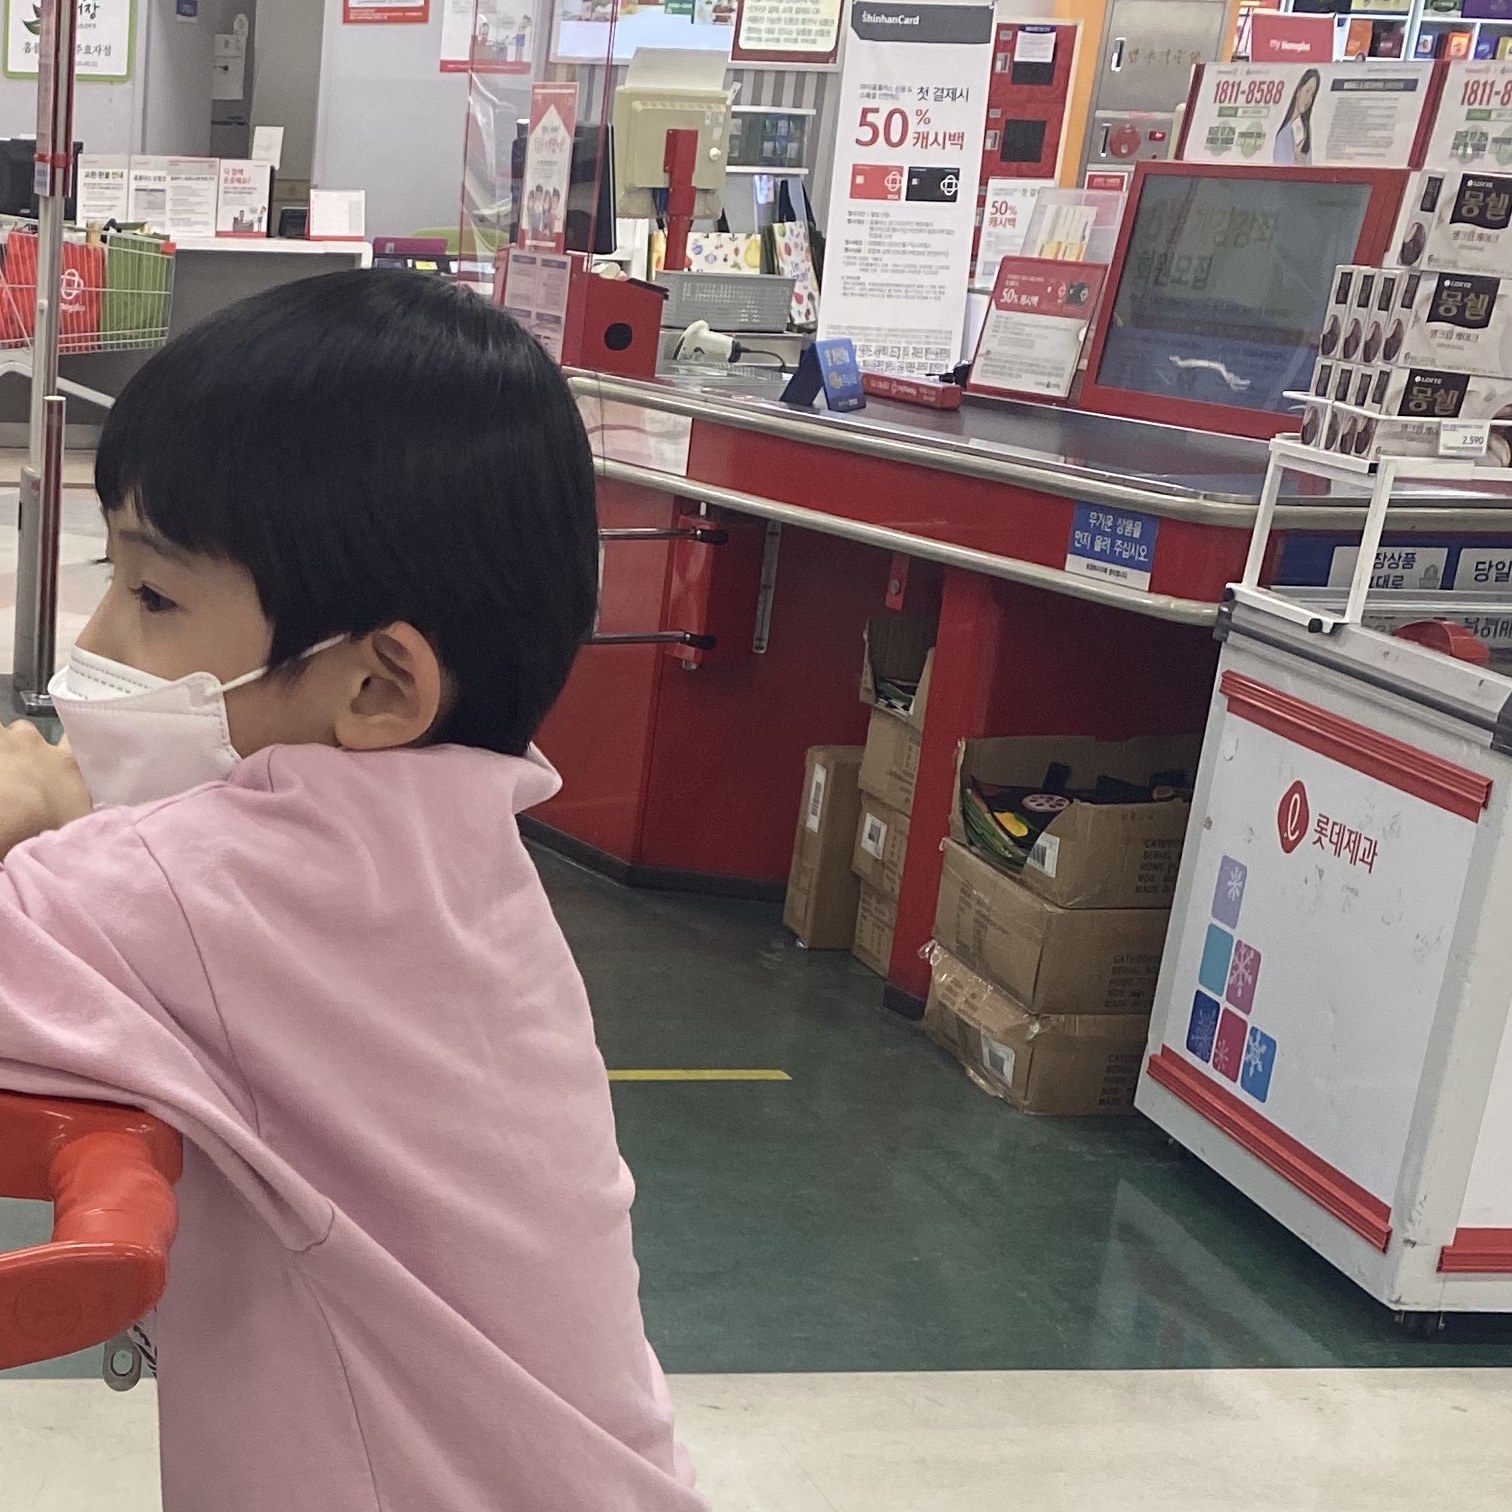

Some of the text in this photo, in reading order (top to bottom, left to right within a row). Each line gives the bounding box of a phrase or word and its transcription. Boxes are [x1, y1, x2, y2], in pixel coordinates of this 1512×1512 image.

[862, 10, 920, 25] ShinhanCard
[917, 86, 969, 102] 첫 결제시
[1213, 79, 1285, 104] 1811-8588
[1460, 80, 1512, 106] 1811-8
[912, 131, 965, 150] 캐시백
[1461, 190, 1510, 220] 몽쉘
[1438, 290, 1489, 321] 몽쉘
[1408, 387, 1459, 416] 몽쉘
[1089, 510, 1143, 539] 무거운 상품을
[1074, 530, 1149, 561] 먼저 올려 주십시오
[1372, 552, 1417, 570] 장상품
[1312, 812, 1379, 875] 롯데제과
